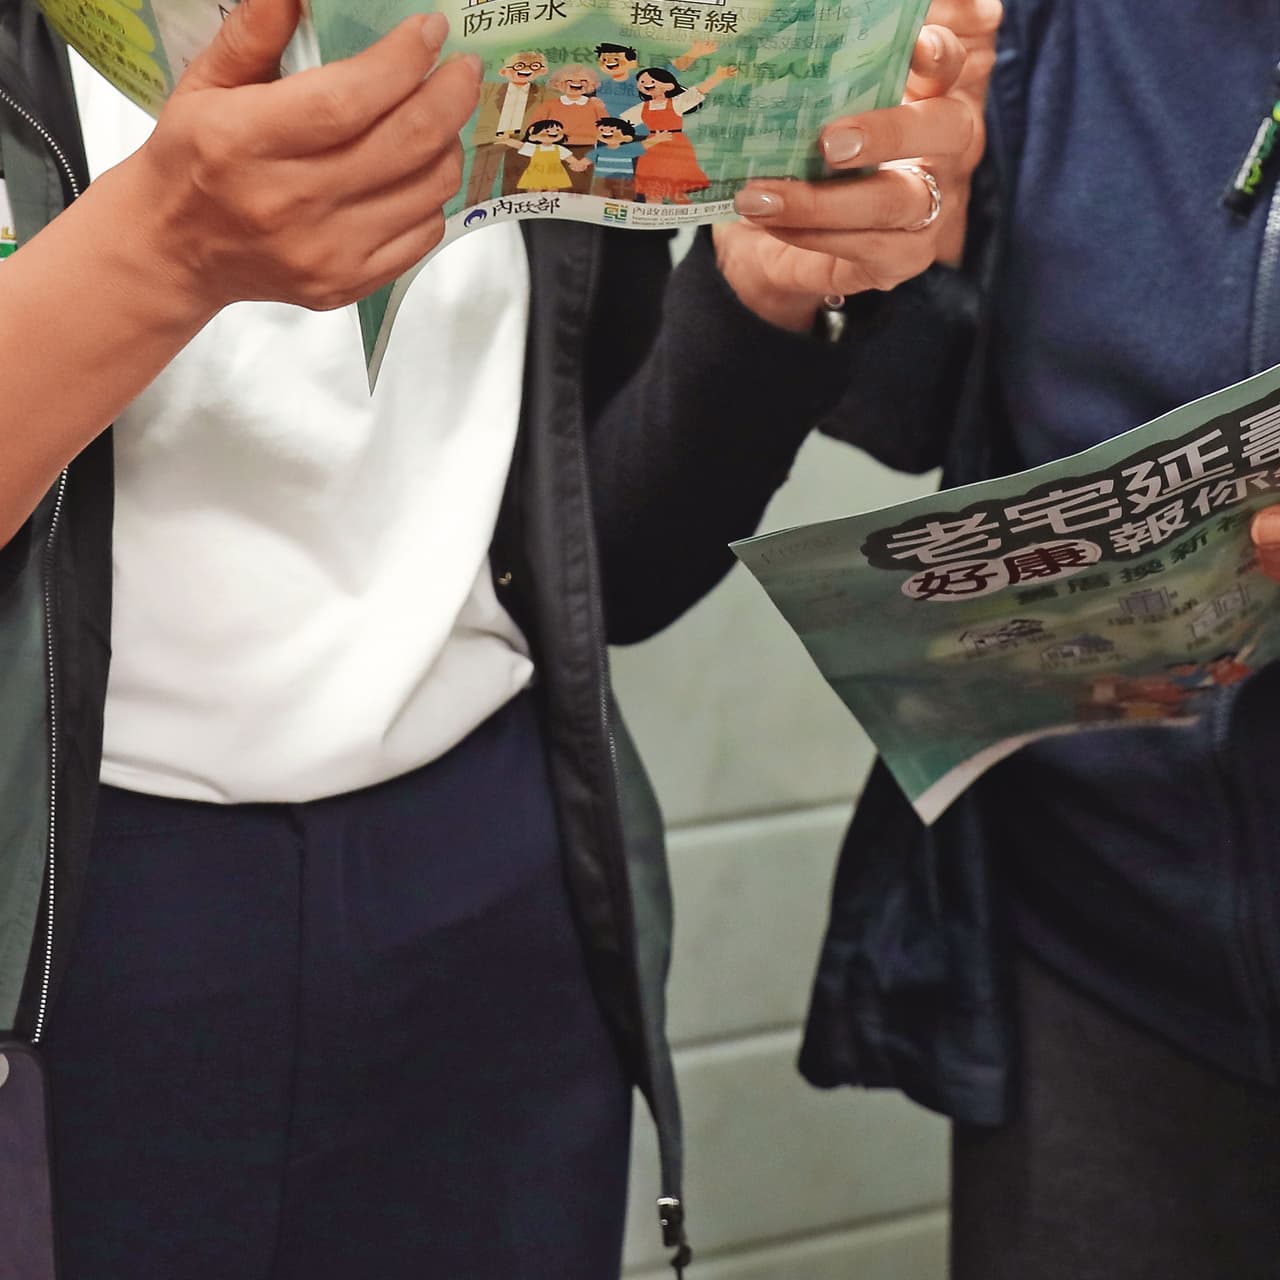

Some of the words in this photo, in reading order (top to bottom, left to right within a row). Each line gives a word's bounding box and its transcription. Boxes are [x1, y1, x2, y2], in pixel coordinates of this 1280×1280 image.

[462, 0, 568, 36] 防漏水
[631, 1, 739, 35] 換管線
[492, 196, 561, 218] 內政部
